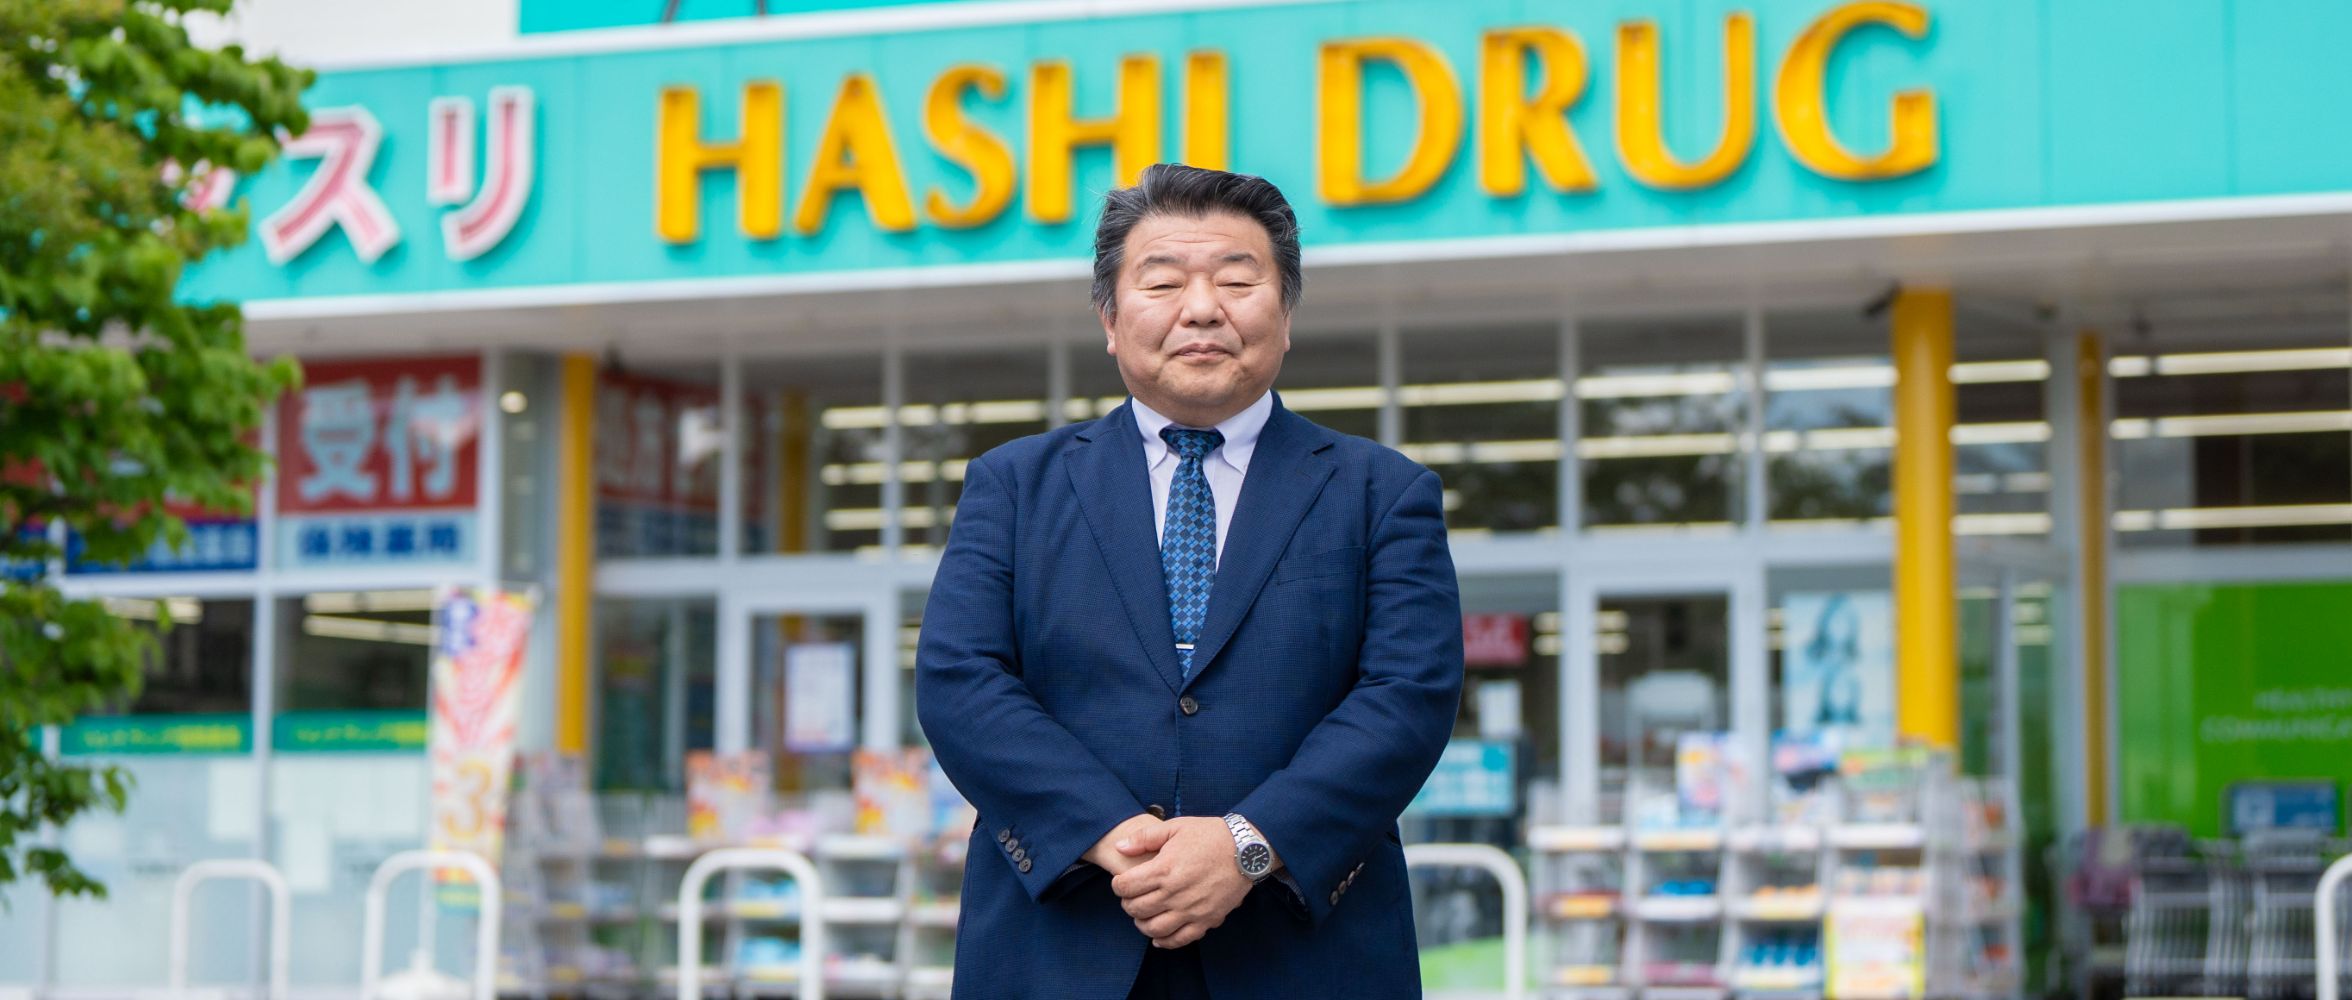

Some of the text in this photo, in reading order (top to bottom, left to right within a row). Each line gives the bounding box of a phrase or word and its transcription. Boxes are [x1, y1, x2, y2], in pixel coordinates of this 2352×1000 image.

[162, 86, 533, 265] スリ
[656, 1, 1938, 244] HASHI DRUG
[300, 375, 472, 500] 受付
